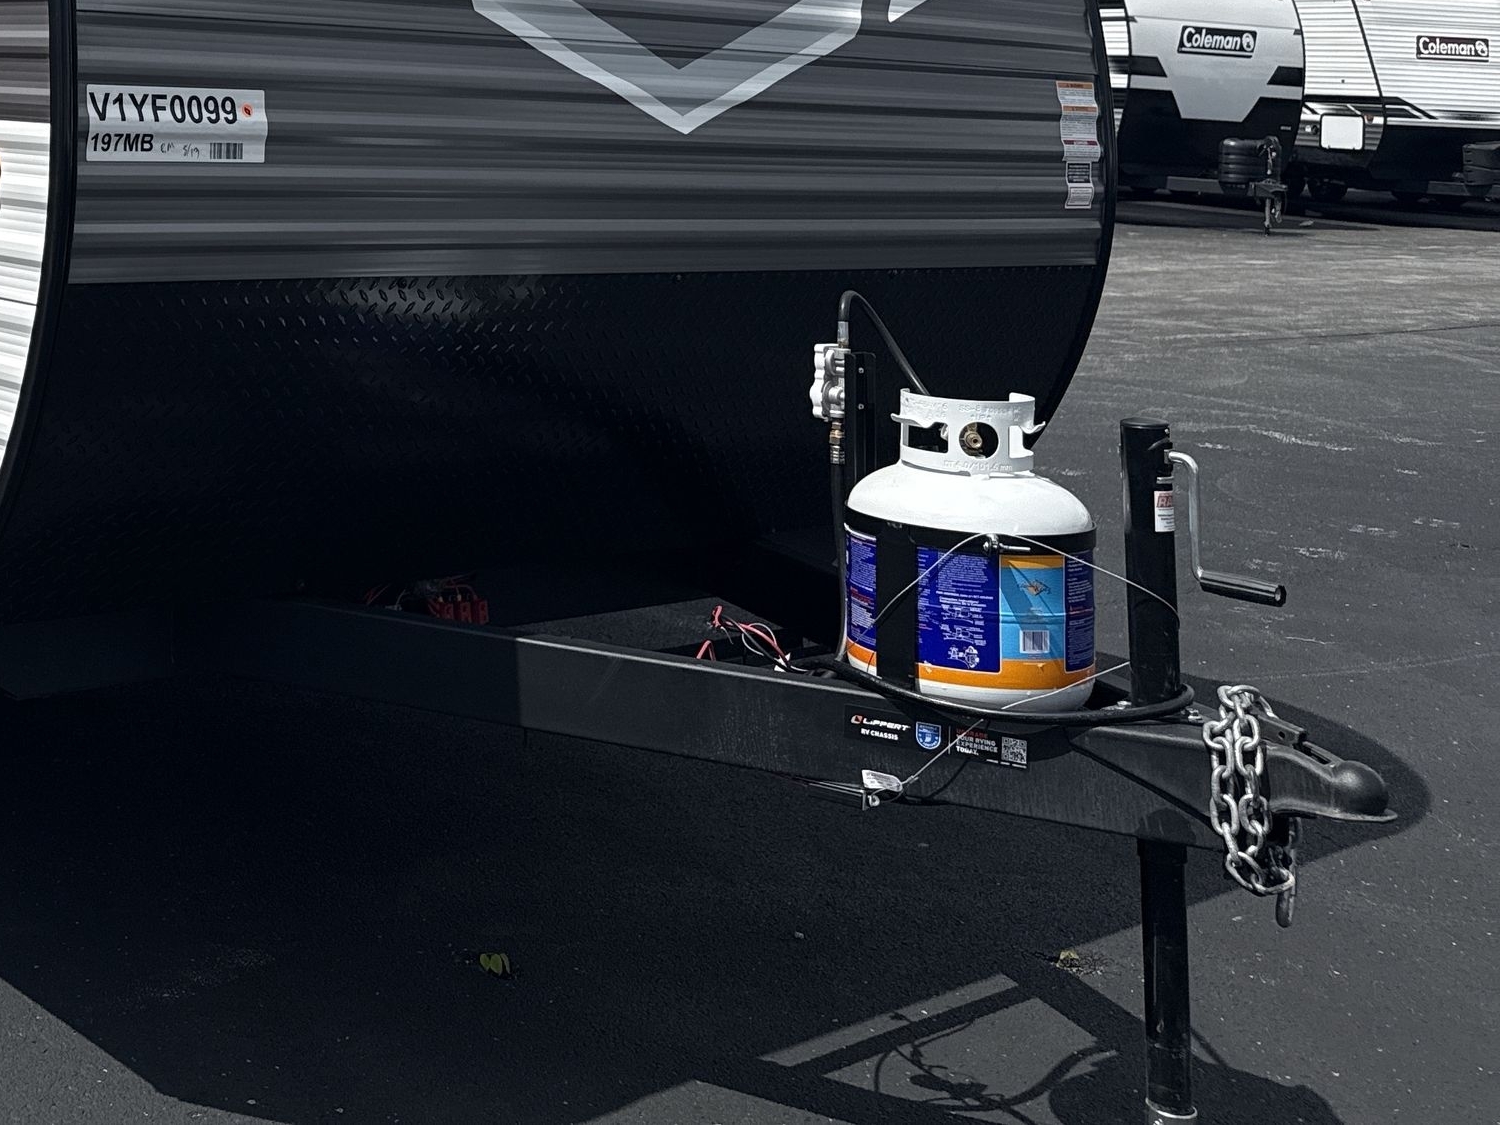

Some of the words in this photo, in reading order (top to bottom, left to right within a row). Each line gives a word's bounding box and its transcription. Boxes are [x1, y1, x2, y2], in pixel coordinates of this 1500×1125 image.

[1183, 27, 1241, 50] Coleman
[1419, 37, 1475, 55] Coleman
[88, 91, 238, 124] V1YF0099
[90, 132, 154, 152] 197MB
[863, 718, 911, 731] LIPPERT
[956, 728, 988, 739] UPRADE
[870, 730, 899, 741] CHASSIS
